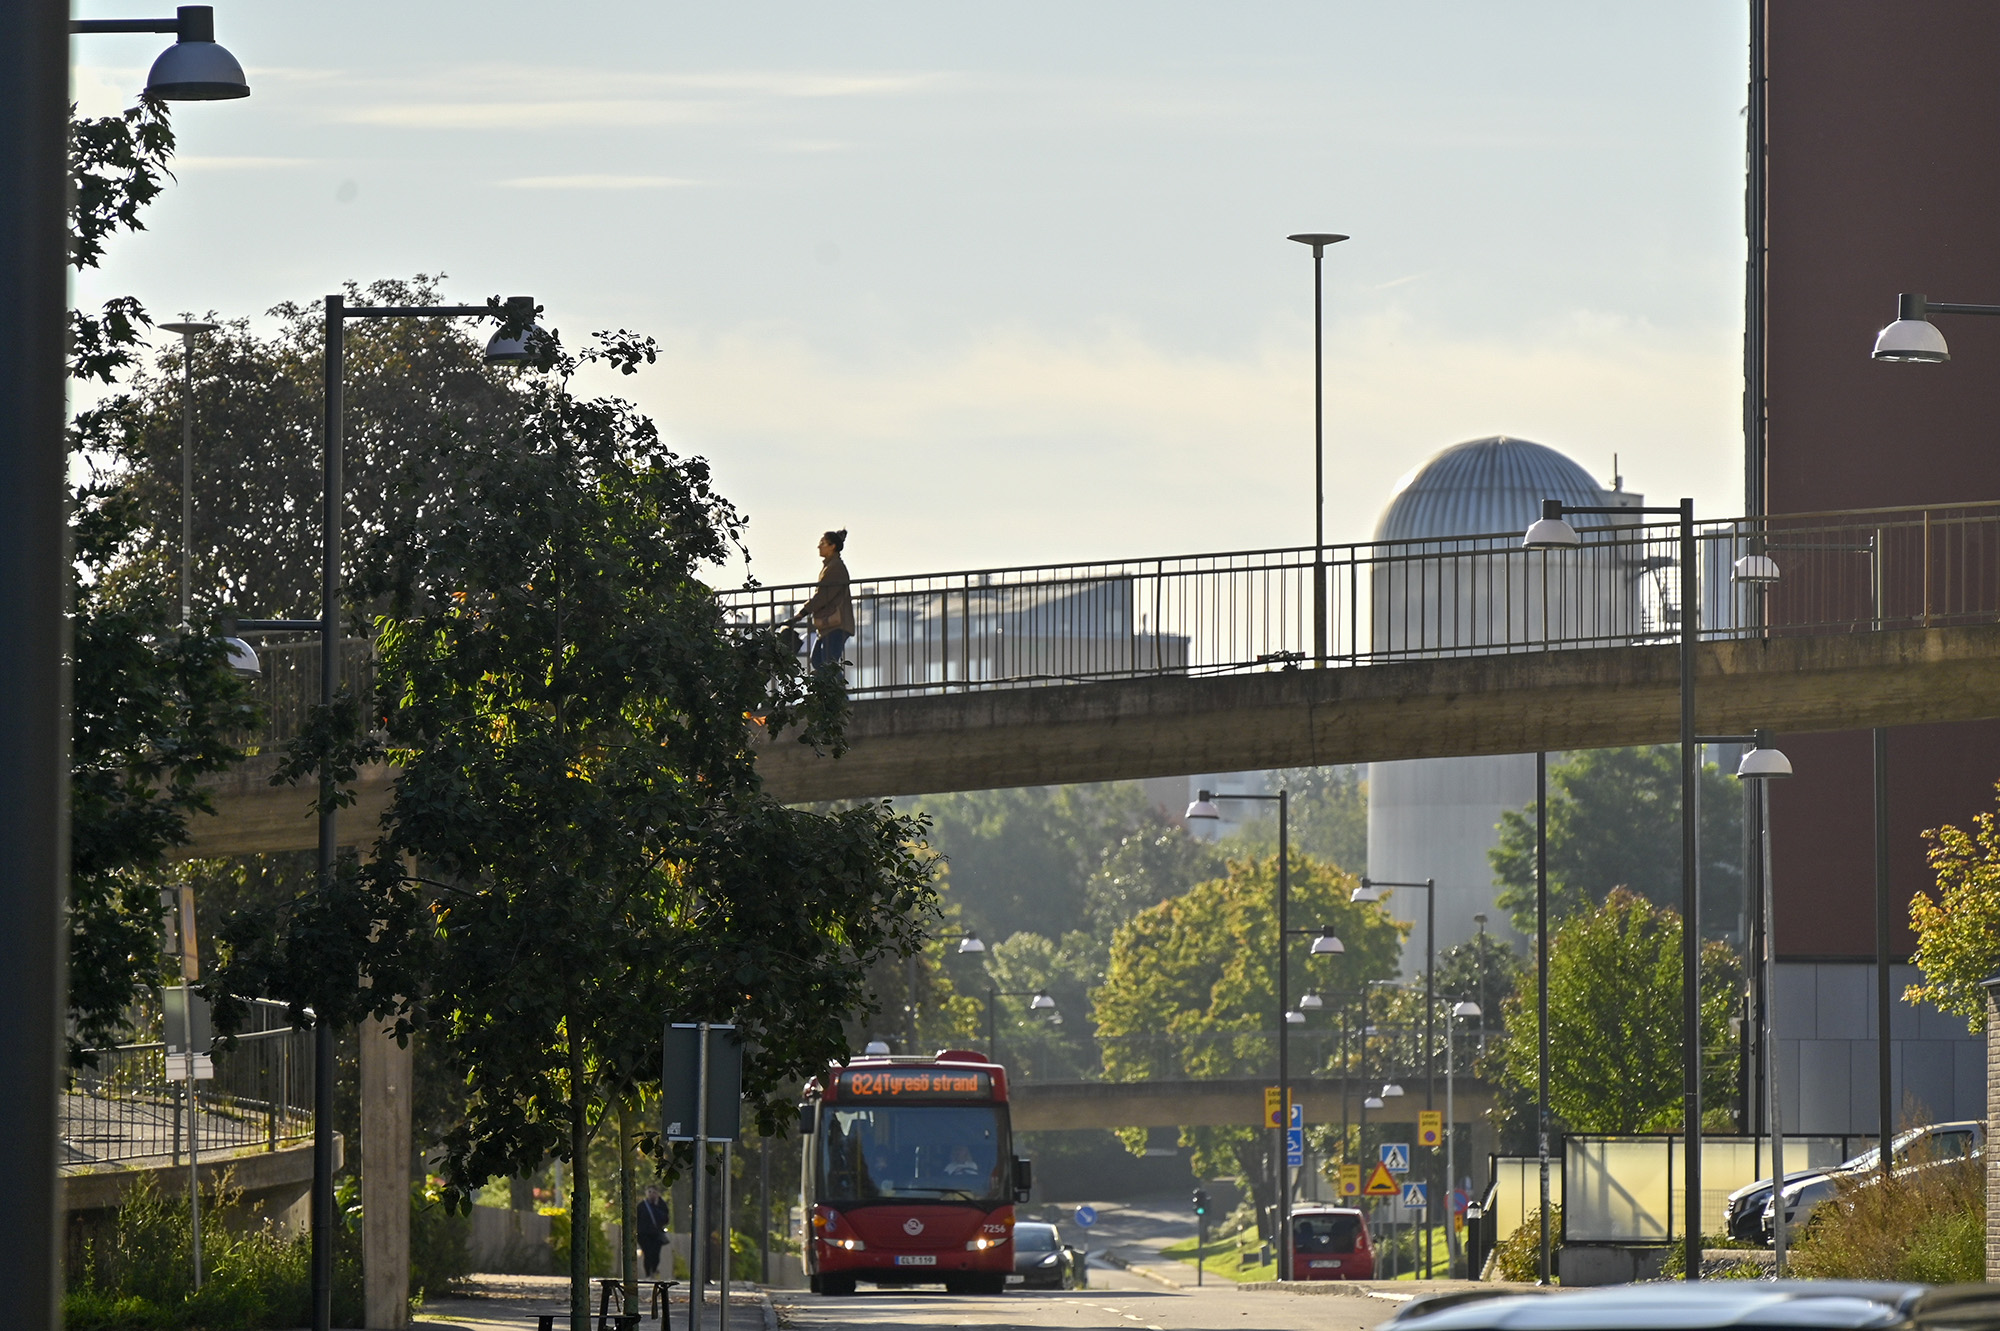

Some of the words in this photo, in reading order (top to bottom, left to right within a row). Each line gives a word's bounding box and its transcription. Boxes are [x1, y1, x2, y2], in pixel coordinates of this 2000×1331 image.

[852, 1073, 882, 1095] 824
[883, 1073, 930, 1095] Tyresö
[933, 1074, 978, 1091] strand
[983, 1224, 1006, 1233] 7256
